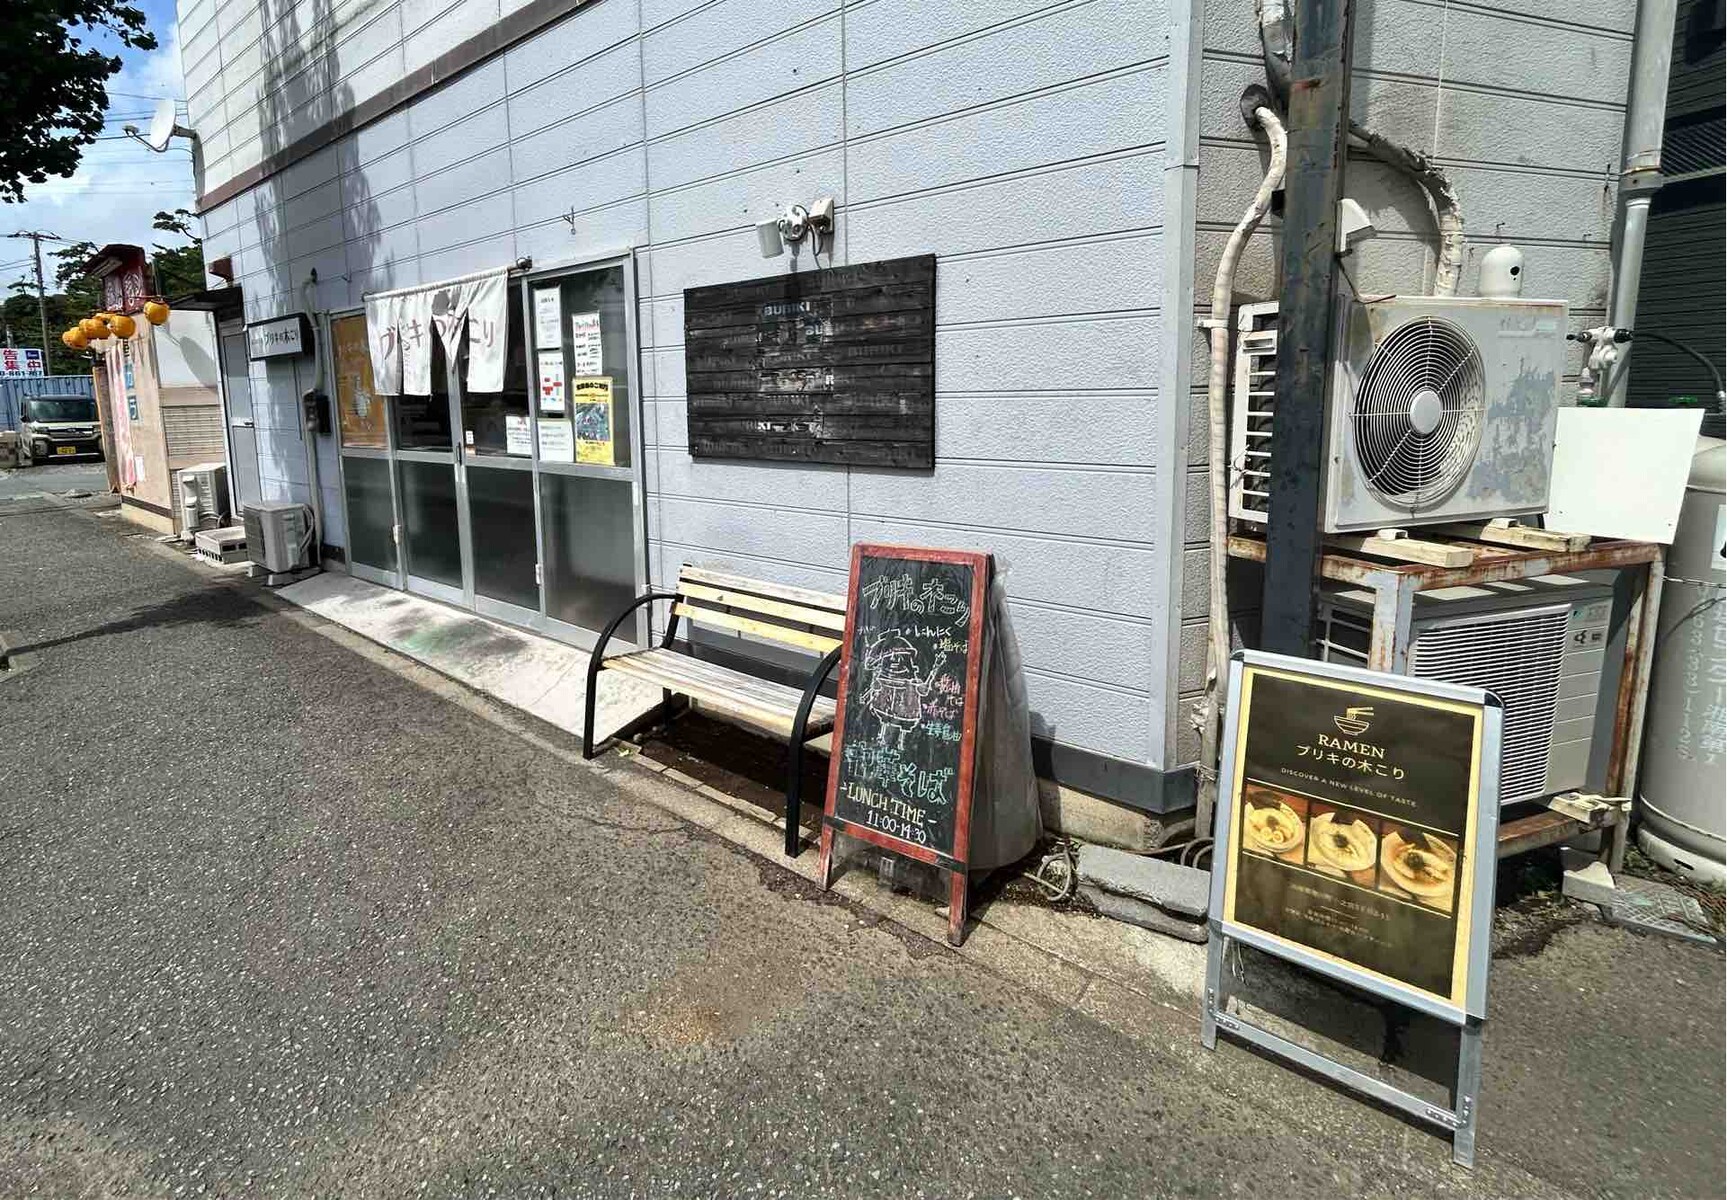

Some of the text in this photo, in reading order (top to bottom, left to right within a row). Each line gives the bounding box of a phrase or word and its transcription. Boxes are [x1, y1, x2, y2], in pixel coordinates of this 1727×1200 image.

[1318, 733, 1385, 760] RAMEN
[1281, 767, 1319, 782] DISCOVER
[1329, 779, 1348, 790] NEW
[1349, 784, 1375, 797] LEVEL
[1376, 791, 1388, 799] OF
[1390, 794, 1417, 808] TASTE
[866, 810, 926, 844] 11:00-14:30
